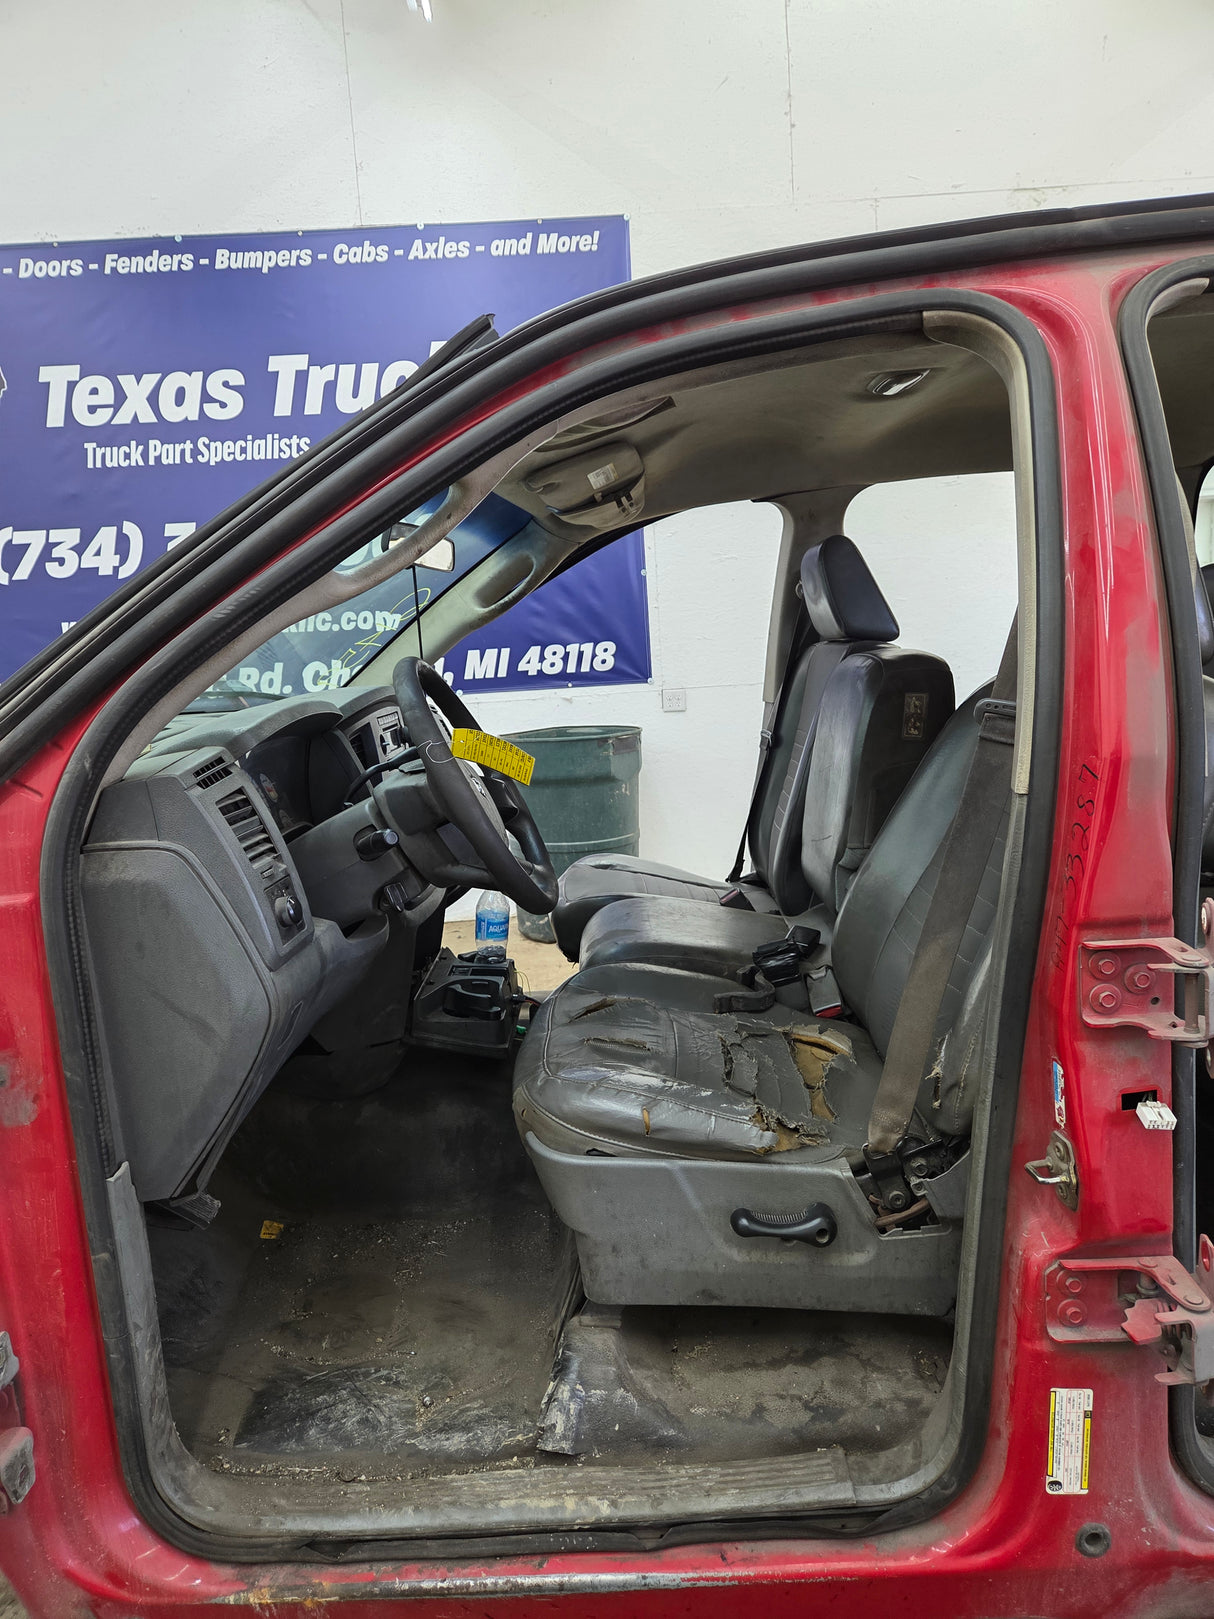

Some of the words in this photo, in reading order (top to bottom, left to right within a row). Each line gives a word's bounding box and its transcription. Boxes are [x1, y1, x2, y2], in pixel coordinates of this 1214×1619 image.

[18, 258, 83, 279] Doors
[104, 250, 194, 275] Fenders
[214, 248, 313, 274] Bumpers
[333, 241, 389, 265] Cabs
[407, 235, 470, 261] Axles
[490, 232, 533, 257] and
[536, 230, 600, 255] More!
[38, 364, 246, 428] Texas
[267, 341, 447, 417] Truc
[84, 440, 145, 469] Truck
[148, 439, 193, 466] Part
[197, 434, 311, 466] Specialists
[0, 520, 144, 586] (734)
[238, 661, 294, 695] Rd.
[463, 647, 511, 680] MI
[517, 641, 617, 676] 48118
